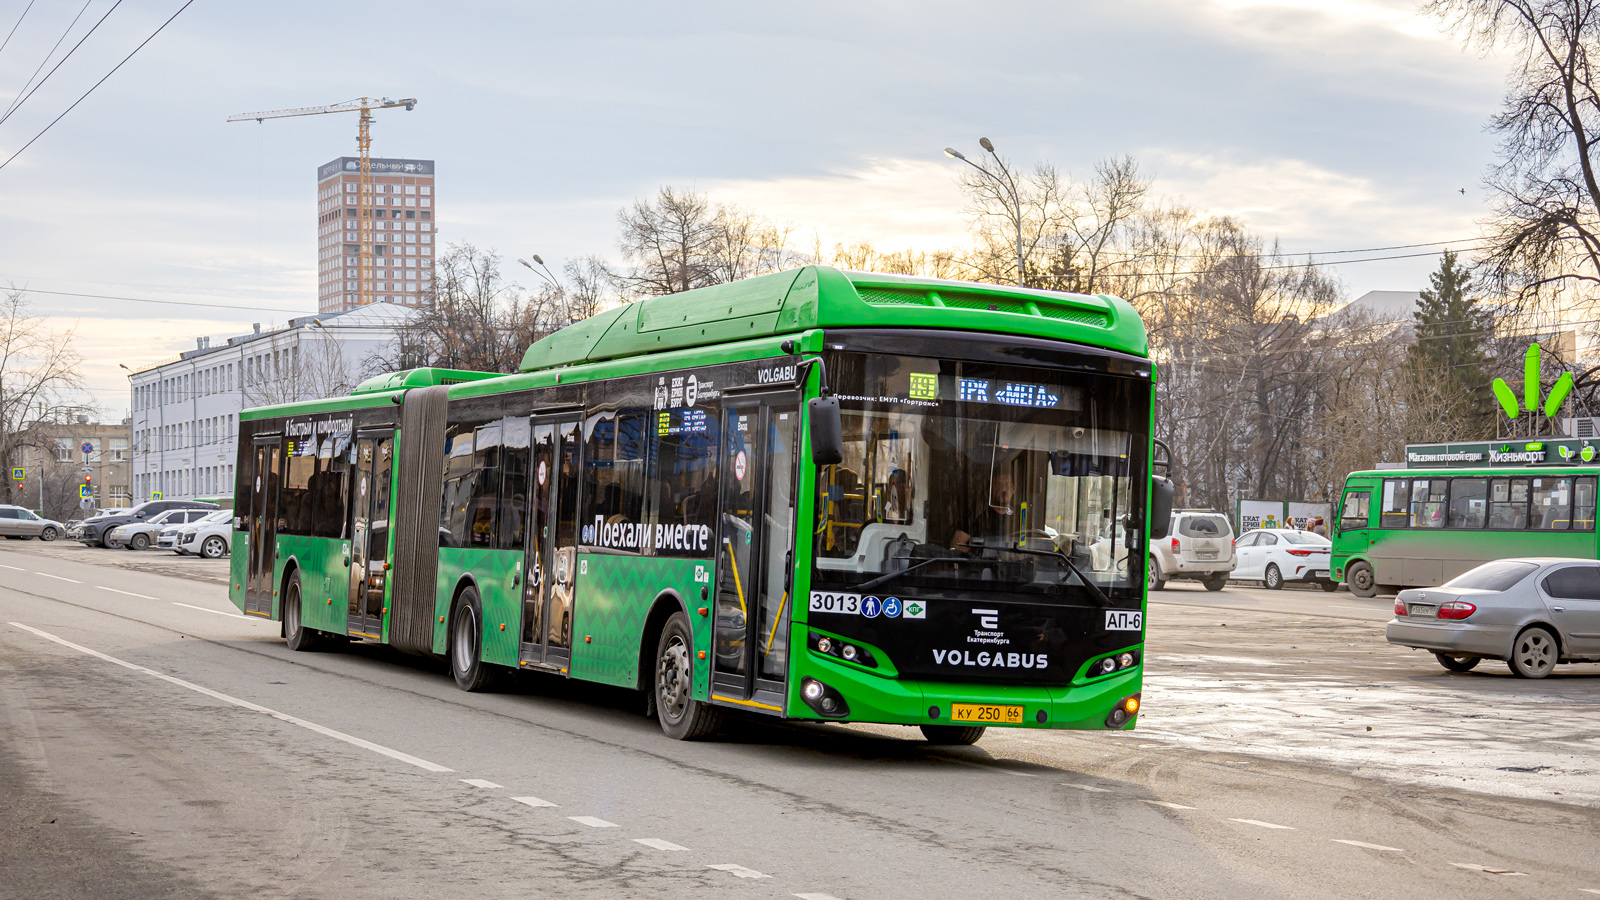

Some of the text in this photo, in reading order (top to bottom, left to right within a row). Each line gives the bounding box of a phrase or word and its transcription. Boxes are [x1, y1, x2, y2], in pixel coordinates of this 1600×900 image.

[758, 365, 797, 383] VOLGABU
[833, 393, 939, 407] Перевозчик: ЕМУП «Гортранс»
[959, 378, 1058, 407] ТРК «МЕГА»
[285, 413, 353, 440] Я быстрый и комфортный
[1408, 451, 1483, 462] Магазин готовой еды
[1488, 450, 1545, 464] Жизньмарт
[593, 514, 709, 551] Поехали вместе
[812, 593, 858, 612] 3013
[1106, 612, 1141, 629] АП-6
[967, 635, 1010, 645] Екатеринбурга
[974, 629, 1004, 638] Транспорт
[932, 649, 1048, 669] VOLGABUS
[977, 706, 1000, 720] 250
[1007, 707, 1019, 717] 66
